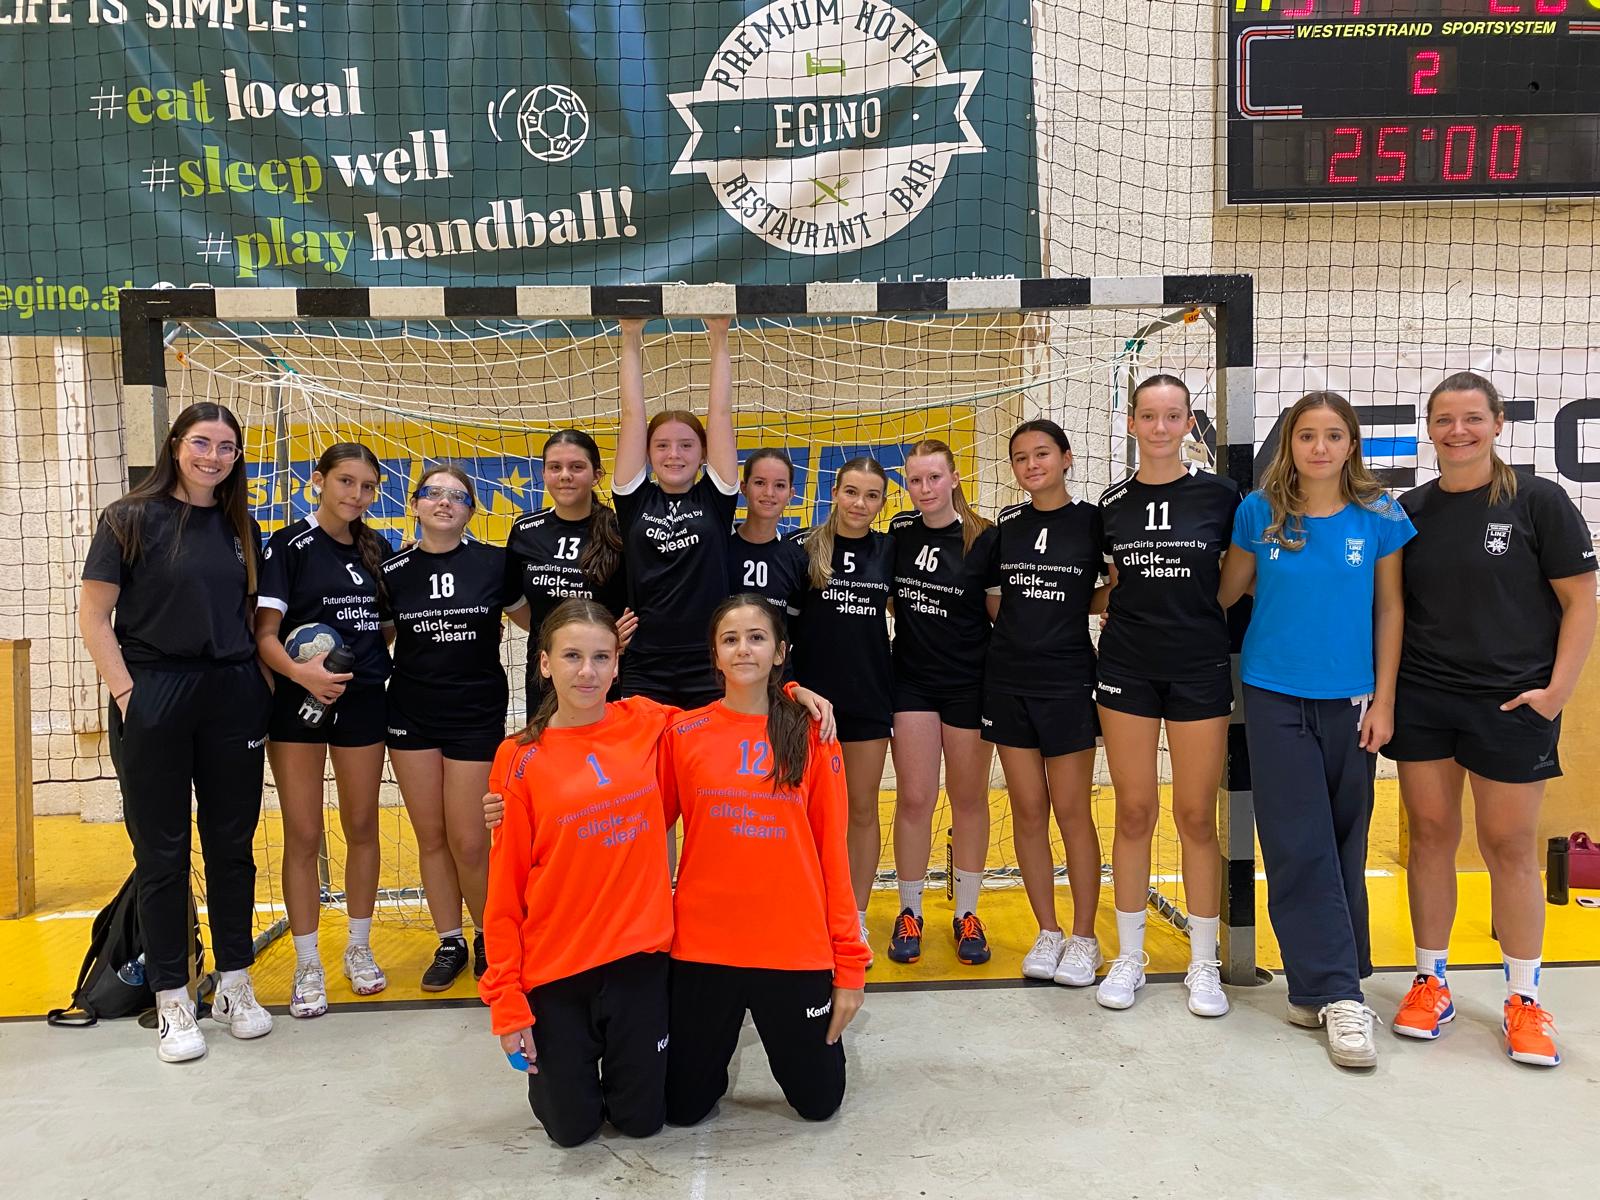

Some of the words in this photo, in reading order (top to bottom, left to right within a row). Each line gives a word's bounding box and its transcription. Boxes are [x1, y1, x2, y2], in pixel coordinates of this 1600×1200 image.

[88, 0, 128, 25] IS
[146, 0, 307, 33] SIMPLE:
[1297, 23, 1433, 38] WESTERSTRAND
[1441, 21, 1557, 35] SPORTSYSTEM
[711, 0, 840, 92] PREMIUM
[854, 0, 938, 78] HOTEL
[1413, 50, 1441, 95] 2
[89, 77, 214, 125] #eat
[225, 66, 365, 122] local
[774, 97, 882, 148] EGINO
[141, 145, 324, 204] #sleep
[330, 129, 454, 188] well
[722, 172, 872, 248] RESTAURANT
[889, 159, 935, 212] BAR
[197, 216, 357, 279] #play
[363, 186, 639, 263] handball!
[1102, 487, 1128, 508] Kempa
[520, 519, 545, 531] Kempa
[1000, 509, 1021, 524] Kempa
[1145, 501, 1172, 531] 11
[675, 528, 688, 537] and
[1034, 528, 1048, 554] 4
[553, 537, 581, 560] 13
[665, 534, 699, 553] learn
[1113, 540, 1154, 551] FutureGirls
[1156, 540, 1196, 548] powered
[1197, 540, 1208, 550] by
[843, 552, 856, 573] 5
[914, 545, 940, 573] 46
[1269, 548, 1280, 560] 14
[346, 563, 363, 585] 6
[383, 557, 410, 574] Kempa
[743, 560, 768, 588] 20
[1037, 564, 1072, 573] powered
[1073, 566, 1083, 576] by
[1151, 565, 1191, 578] learn
[429, 573, 455, 599] 18
[556, 587, 593, 599] learn
[851, 580, 882, 590] powered
[883, 583, 890, 592] by
[922, 582, 954, 593] powered
[954, 587, 965, 596] by
[1031, 586, 1065, 601] learn
[323, 595, 361, 605] FutureGirls
[845, 603, 877, 616] learn
[400, 609, 442, 620] FutureGirls
[444, 606, 479, 616] powered
[480, 605, 489, 614] by
[917, 602, 948, 618] learn
[360, 619, 380, 631] lear
[441, 631, 477, 642] learn
[1097, 681, 1121, 696] Kempa
[677, 716, 710, 735] Kempa
[514, 746, 538, 780] Kempa
[736, 739, 769, 776] 12
[586, 753, 612, 787] 1
[741, 819, 787, 840] learn
[806, 998, 832, 1018] Kemp
